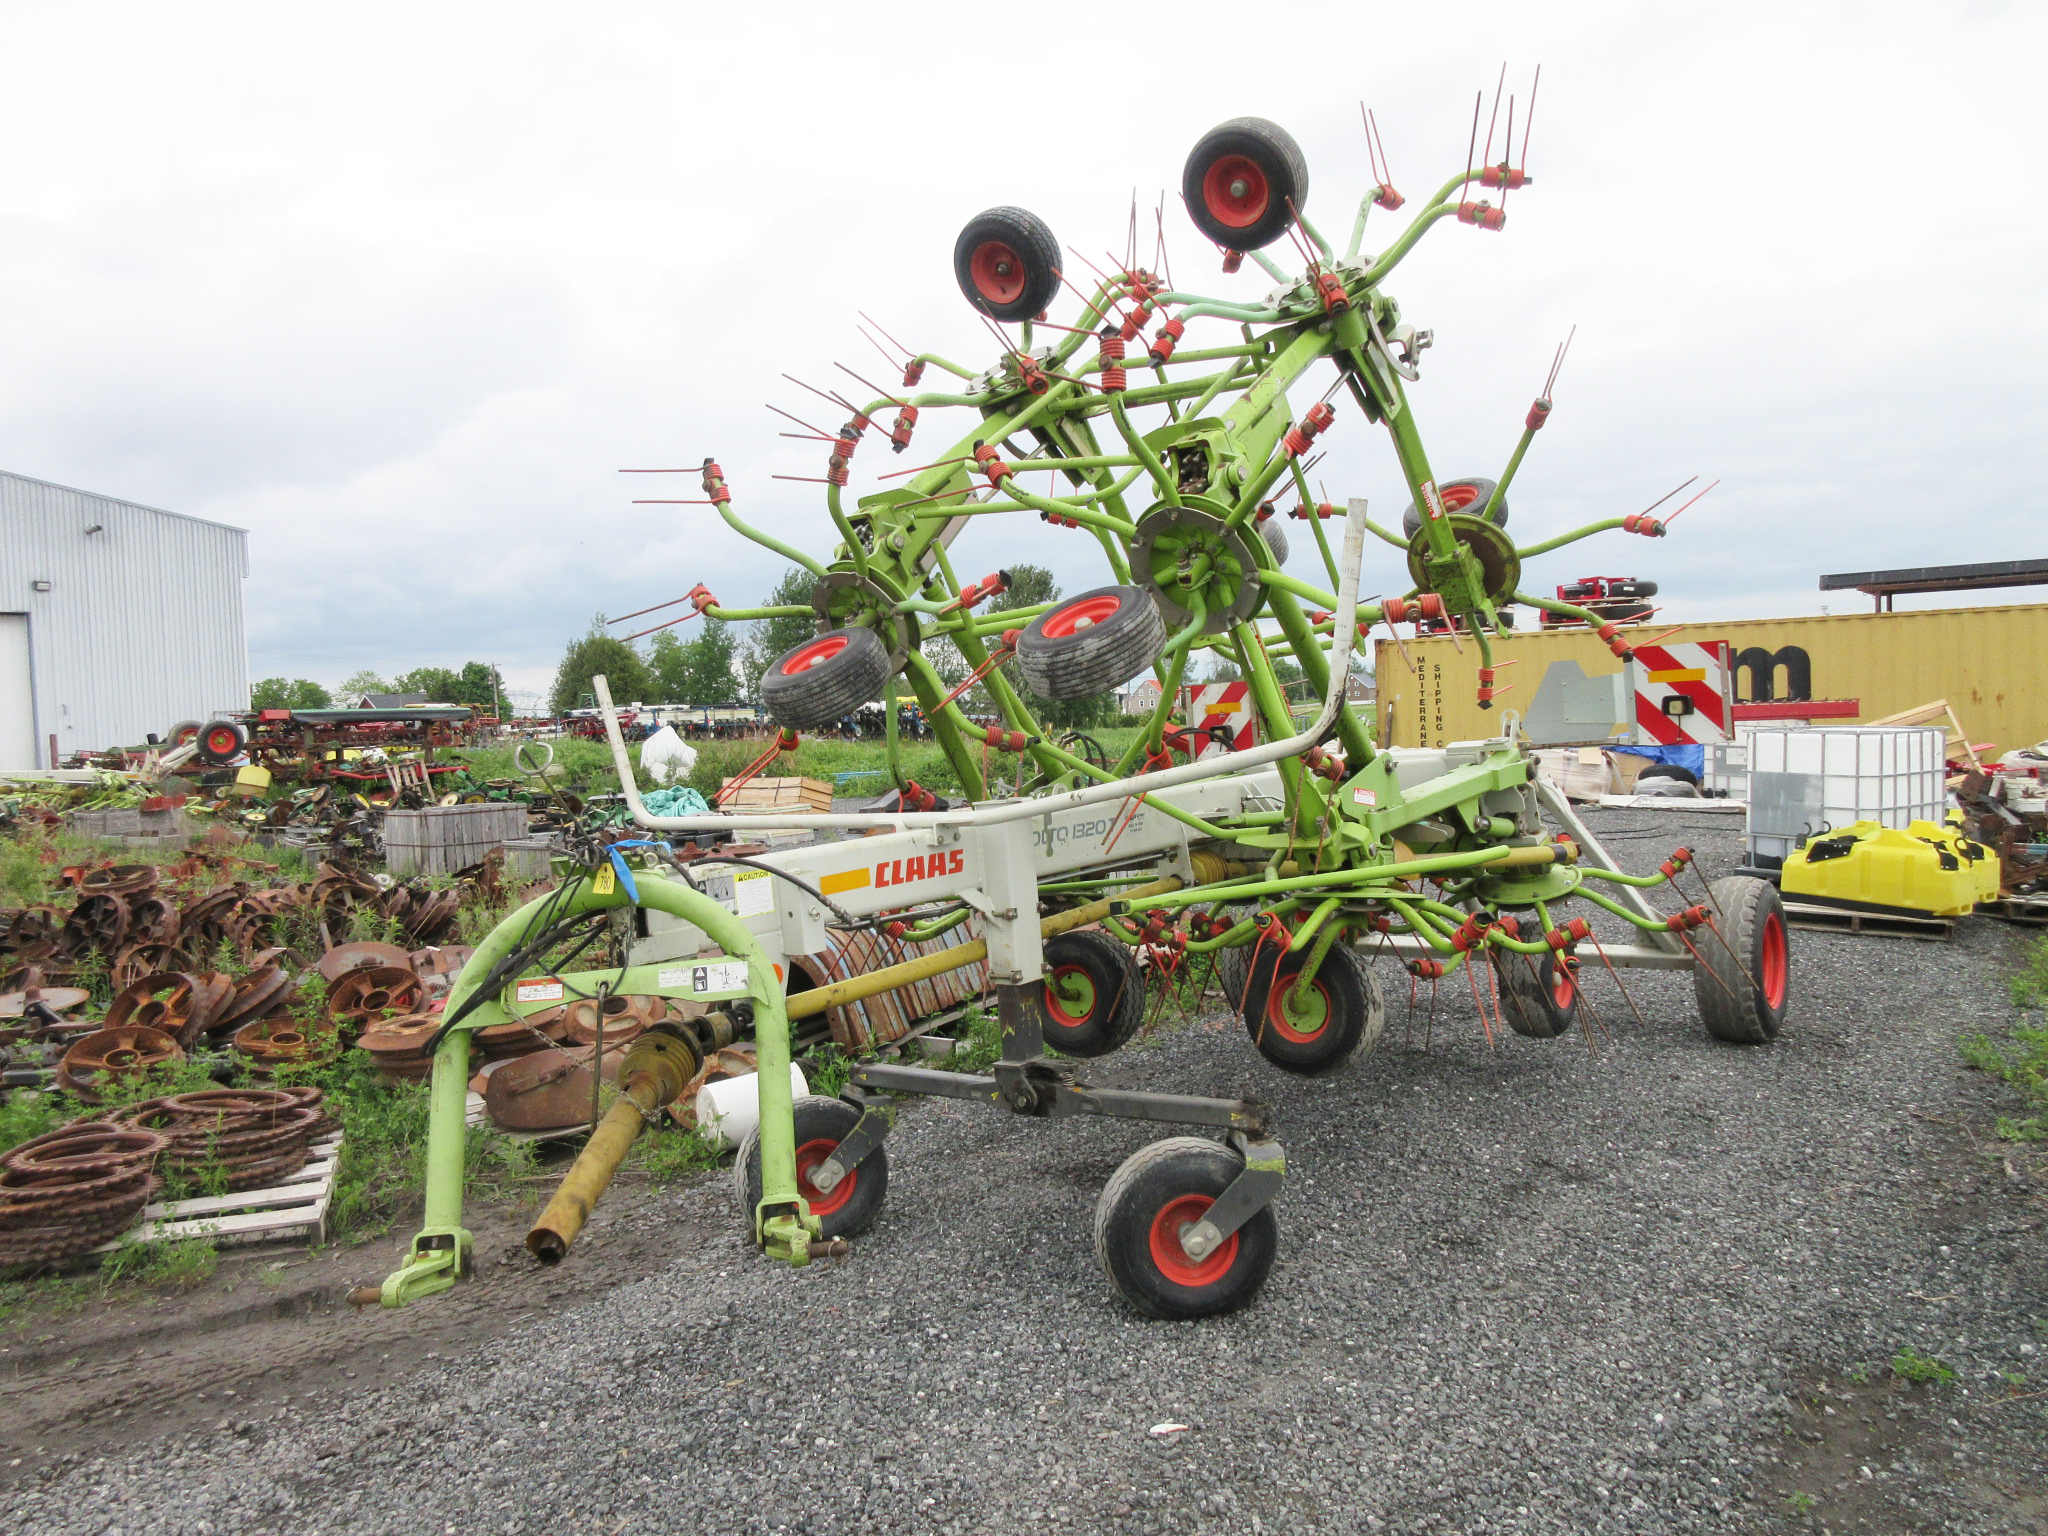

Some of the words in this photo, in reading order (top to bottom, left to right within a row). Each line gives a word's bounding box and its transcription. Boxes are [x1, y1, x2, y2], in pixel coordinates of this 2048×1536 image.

[1417, 656, 1427, 747] MEDITERRANE
[1434, 664, 1443, 731] SHIPPING
[1072, 819, 1107, 840] 1320
[600, 875, 612, 890] 780
[743, 869, 770, 881] CAUTION
[874, 848, 964, 889] CLAAS
